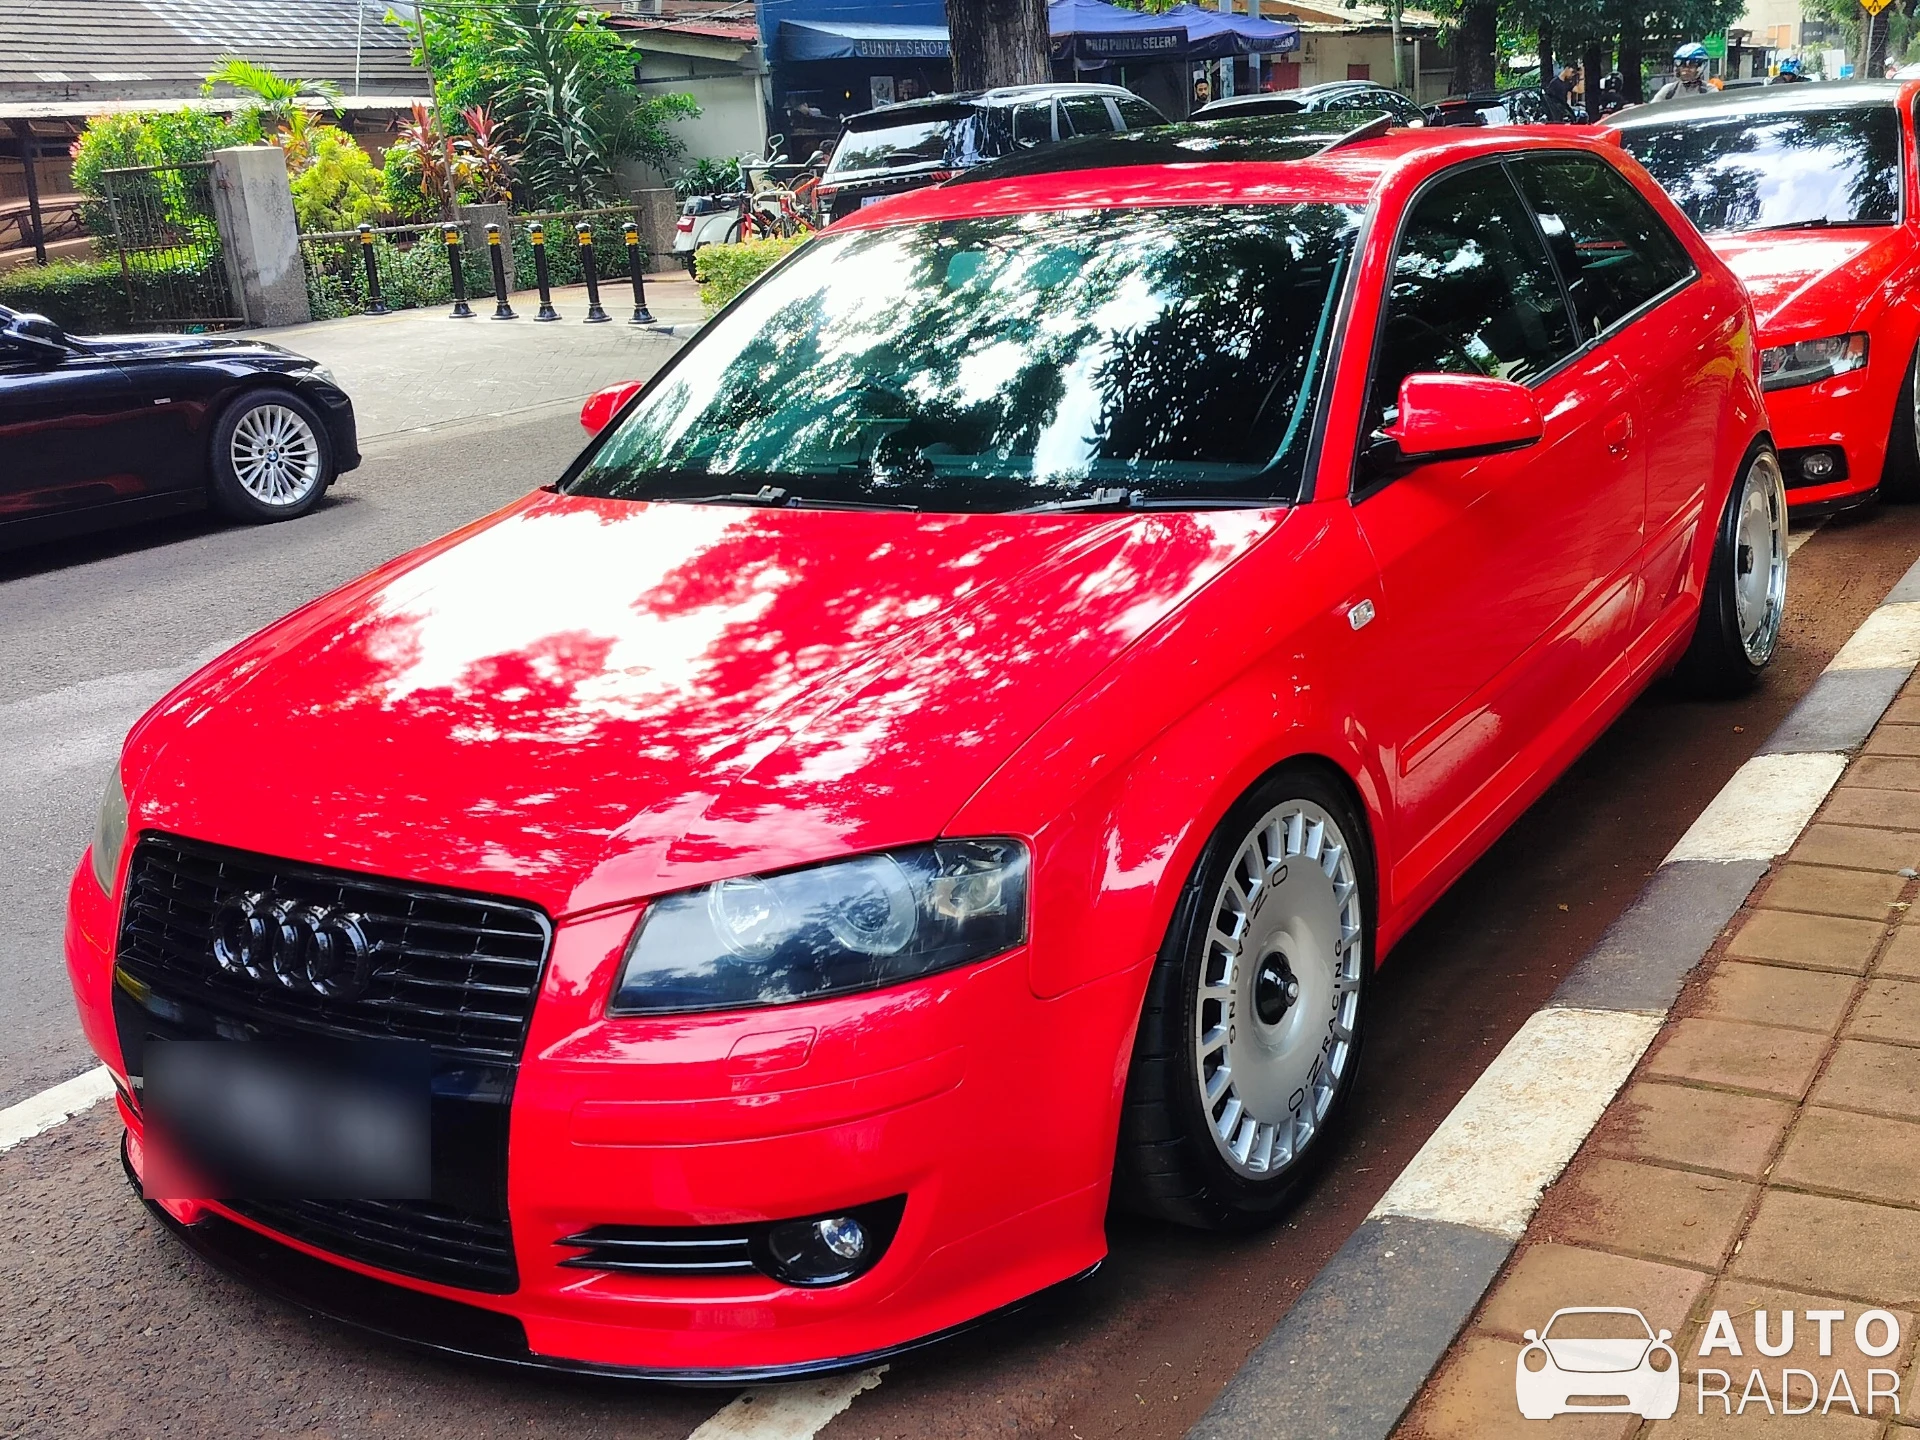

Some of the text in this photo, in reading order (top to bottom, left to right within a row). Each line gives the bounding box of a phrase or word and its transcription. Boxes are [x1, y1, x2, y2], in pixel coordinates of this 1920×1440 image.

[1142, 35, 1177, 49] SELERA
[1228, 918, 1251, 1044] RACING
[1321, 939, 1342, 1053] RACING
